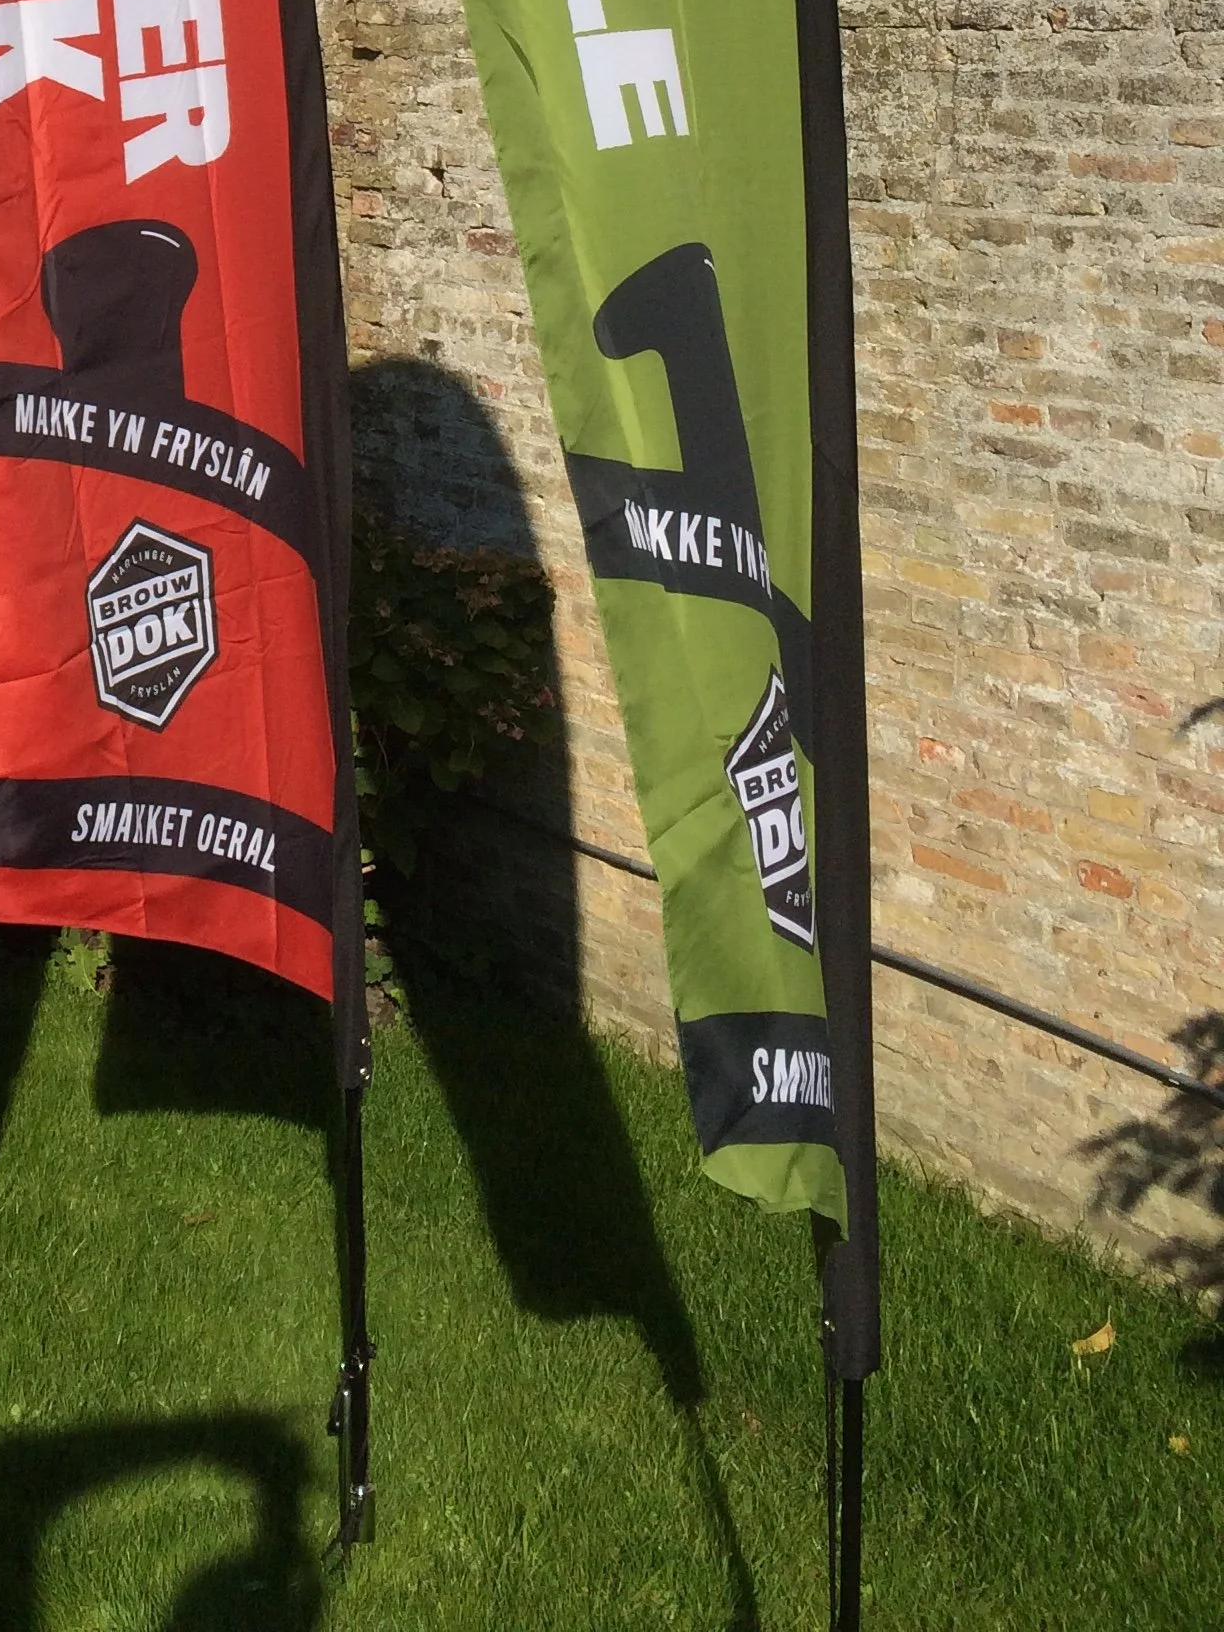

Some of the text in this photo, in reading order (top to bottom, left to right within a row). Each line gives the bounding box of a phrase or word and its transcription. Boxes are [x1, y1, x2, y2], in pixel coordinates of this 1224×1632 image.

[15, 392, 271, 501] MAKKE YN FRYSLÂN
[112, 548, 174, 584] HARLINGEN
[730, 522, 759, 582] YN
[98, 572, 193, 619] BROUW
[106, 601, 194, 670] DOK
[743, 758, 797, 803] BRO
[71, 802, 276, 873] SMAKKET OERAL
[757, 795, 805, 869] DO
